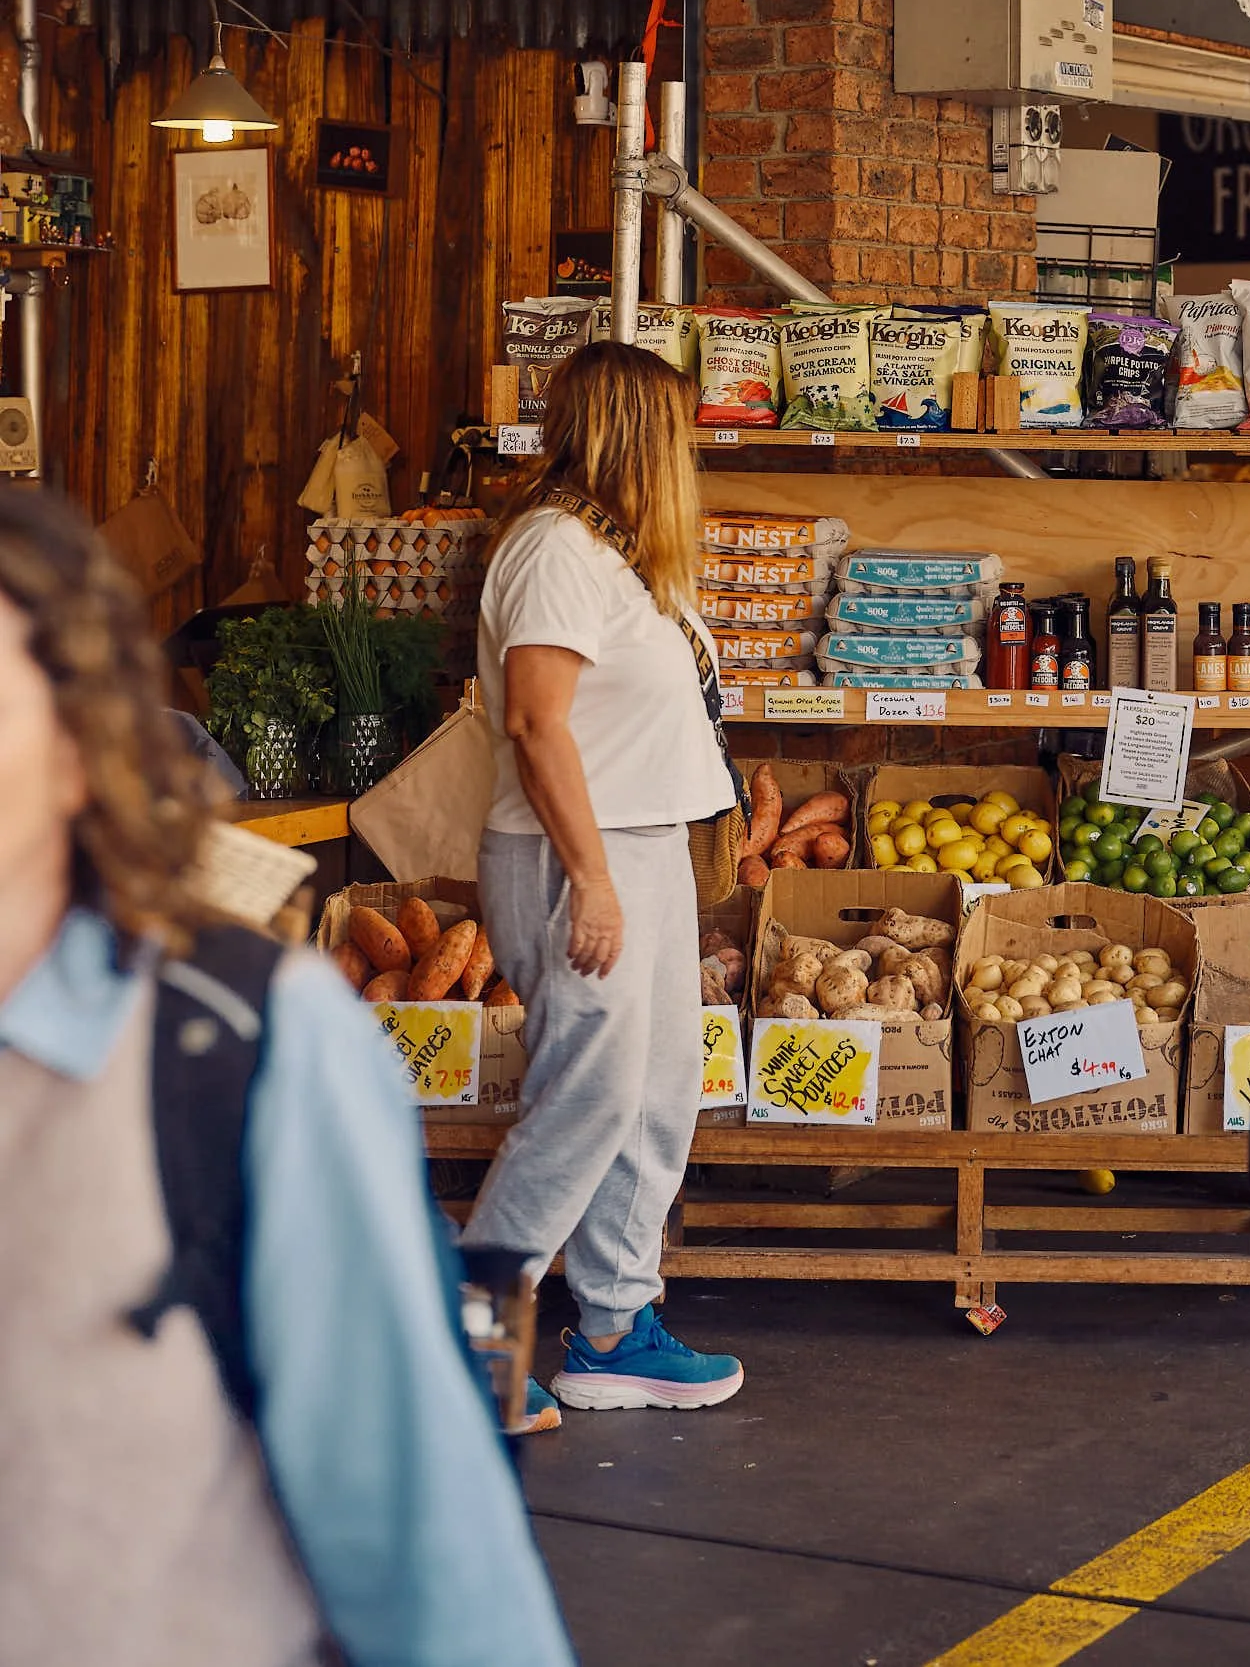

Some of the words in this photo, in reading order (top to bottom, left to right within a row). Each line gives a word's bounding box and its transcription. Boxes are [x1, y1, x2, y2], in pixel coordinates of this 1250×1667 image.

[506, 343, 551, 354] CRINKLE
[553, 346, 576, 355] CUT
[706, 357, 738, 366] GHOST
[789, 360, 816, 373] SOUR
[817, 357, 857, 370] CREAM
[1010, 359, 1076, 371] ORIGINAL
[716, 364, 740, 374] SOUR
[742, 367, 770, 378] CREAM
[803, 366, 856, 378] SHAMROCK
[876, 367, 900, 377] SEA
[902, 369, 932, 378] SALT
[1118, 367, 1140, 378] CHIPS
[883, 377, 935, 386] VINEGAR
[722, 639, 782, 659] NEST
[1196, 662, 1225, 674] LANES
[1135, 715, 1155, 726] $20
[1023, 1022, 1084, 1048] EXTON
[1028, 1042, 1062, 1065] CHAT
[1071, 1057, 1116, 1078] $4.99
[1013, 1094, 1168, 1133] POTATOES
